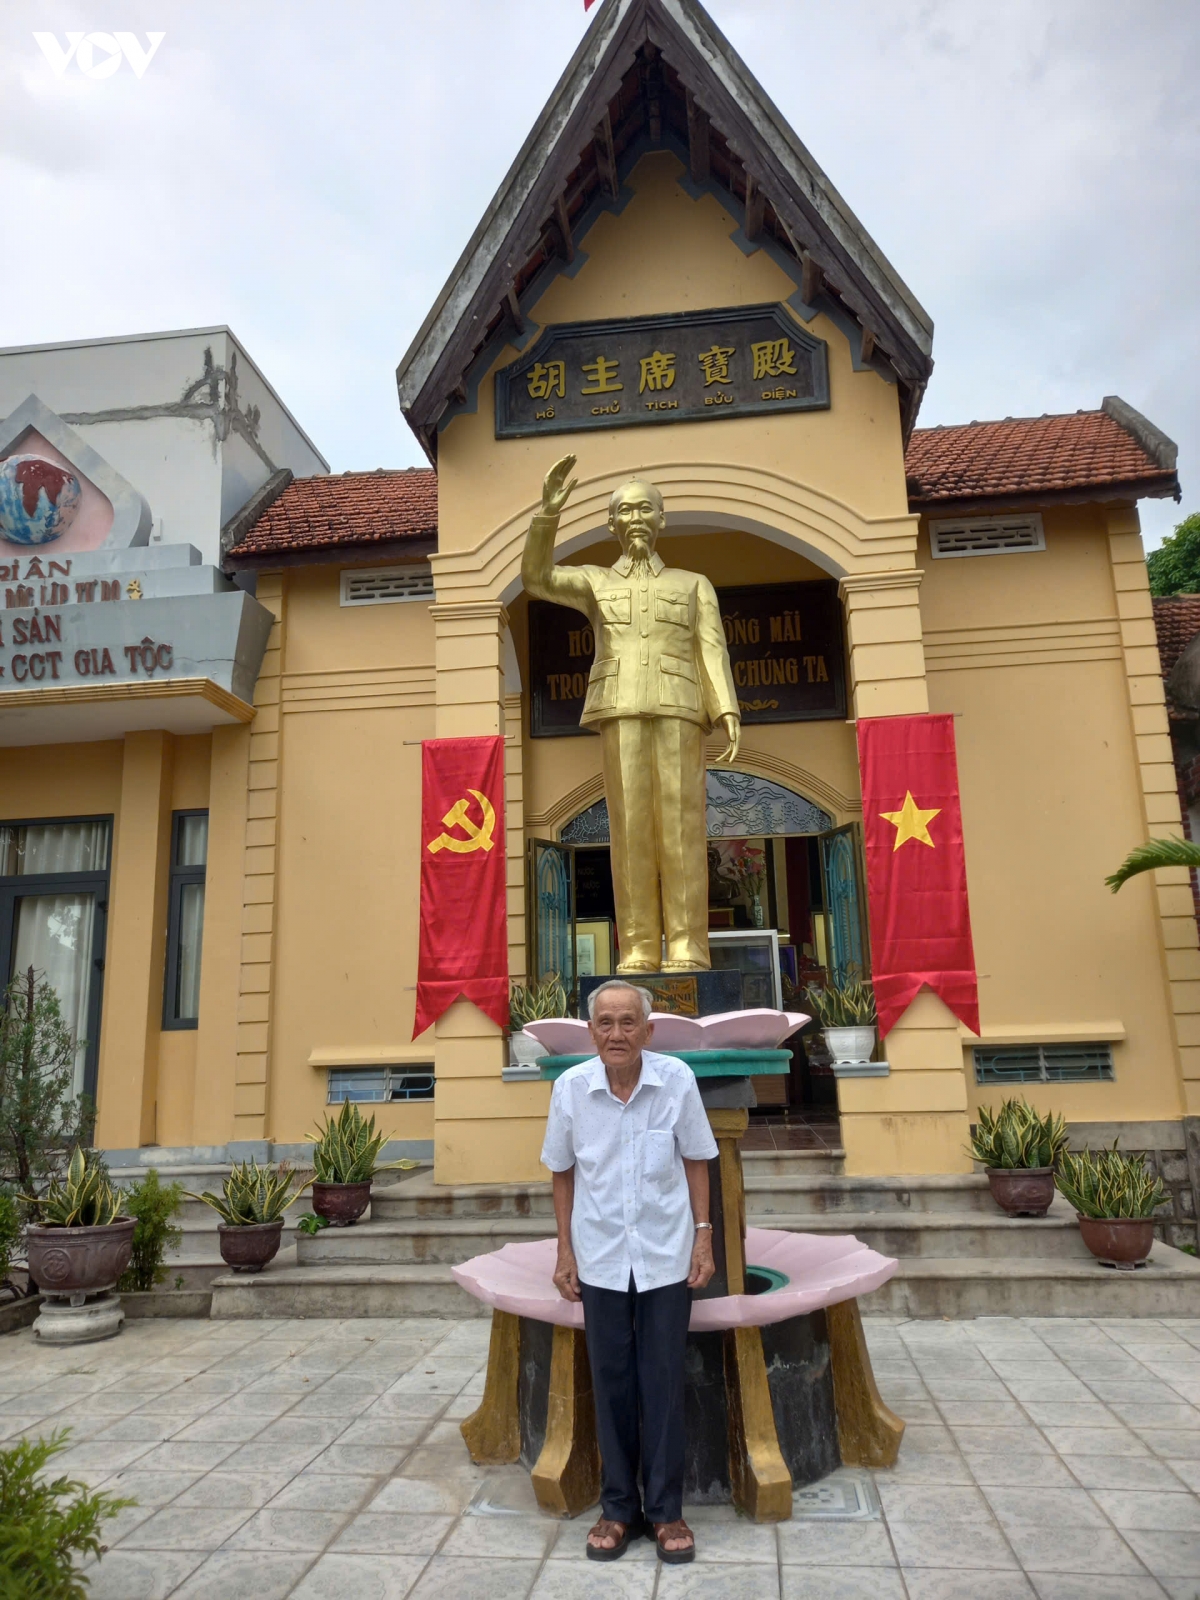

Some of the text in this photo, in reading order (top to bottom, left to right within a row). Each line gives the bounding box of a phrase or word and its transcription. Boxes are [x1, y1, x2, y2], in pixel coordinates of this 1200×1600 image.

[535, 405, 556, 420] HỒ
[590, 400, 621, 415] CHỦ
[645, 399, 678, 412] TỊCH
[704, 390, 733, 405] BỬU
[0, 555, 72, 581] RI ÂN
[101, 579, 121, 602] DO
[12, 608, 62, 645] SẢN
[721, 610, 760, 645] ỐNG
[769, 610, 802, 643] MÃI
[11, 636, 174, 682] CCT GIA TỘC
[547, 651, 830, 701] TRO CHÚNG TA
